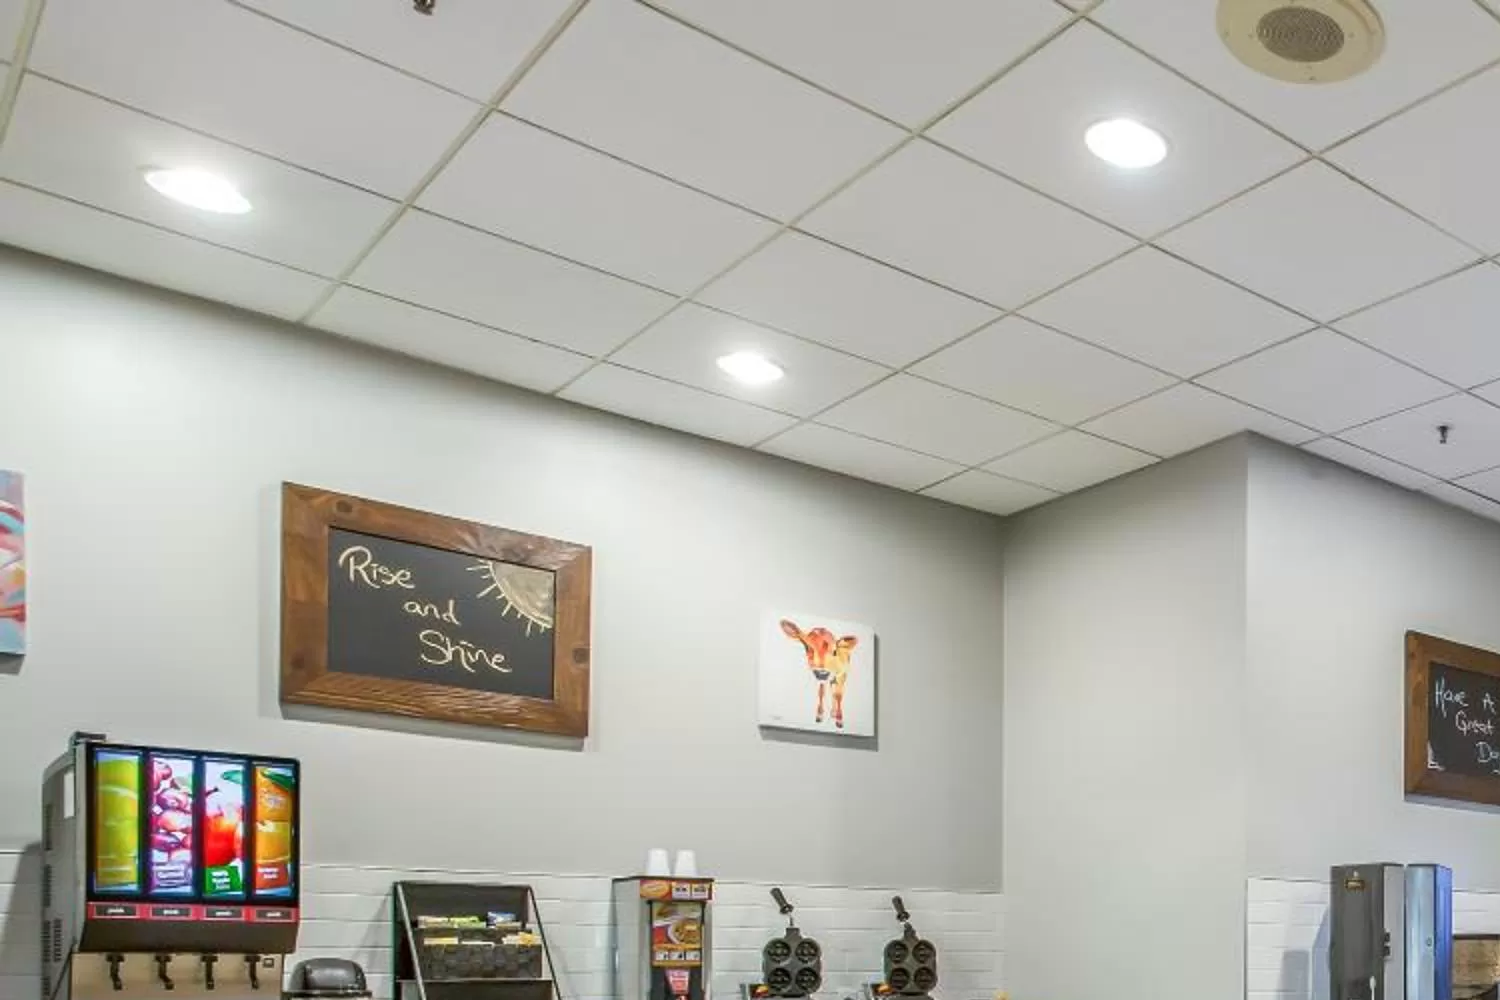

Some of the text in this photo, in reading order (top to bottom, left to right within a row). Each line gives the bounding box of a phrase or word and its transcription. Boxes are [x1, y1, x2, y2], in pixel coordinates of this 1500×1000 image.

[338, 545, 416, 589] Rise
[402, 599, 462, 627] and
[418, 629, 513, 673] Shine
